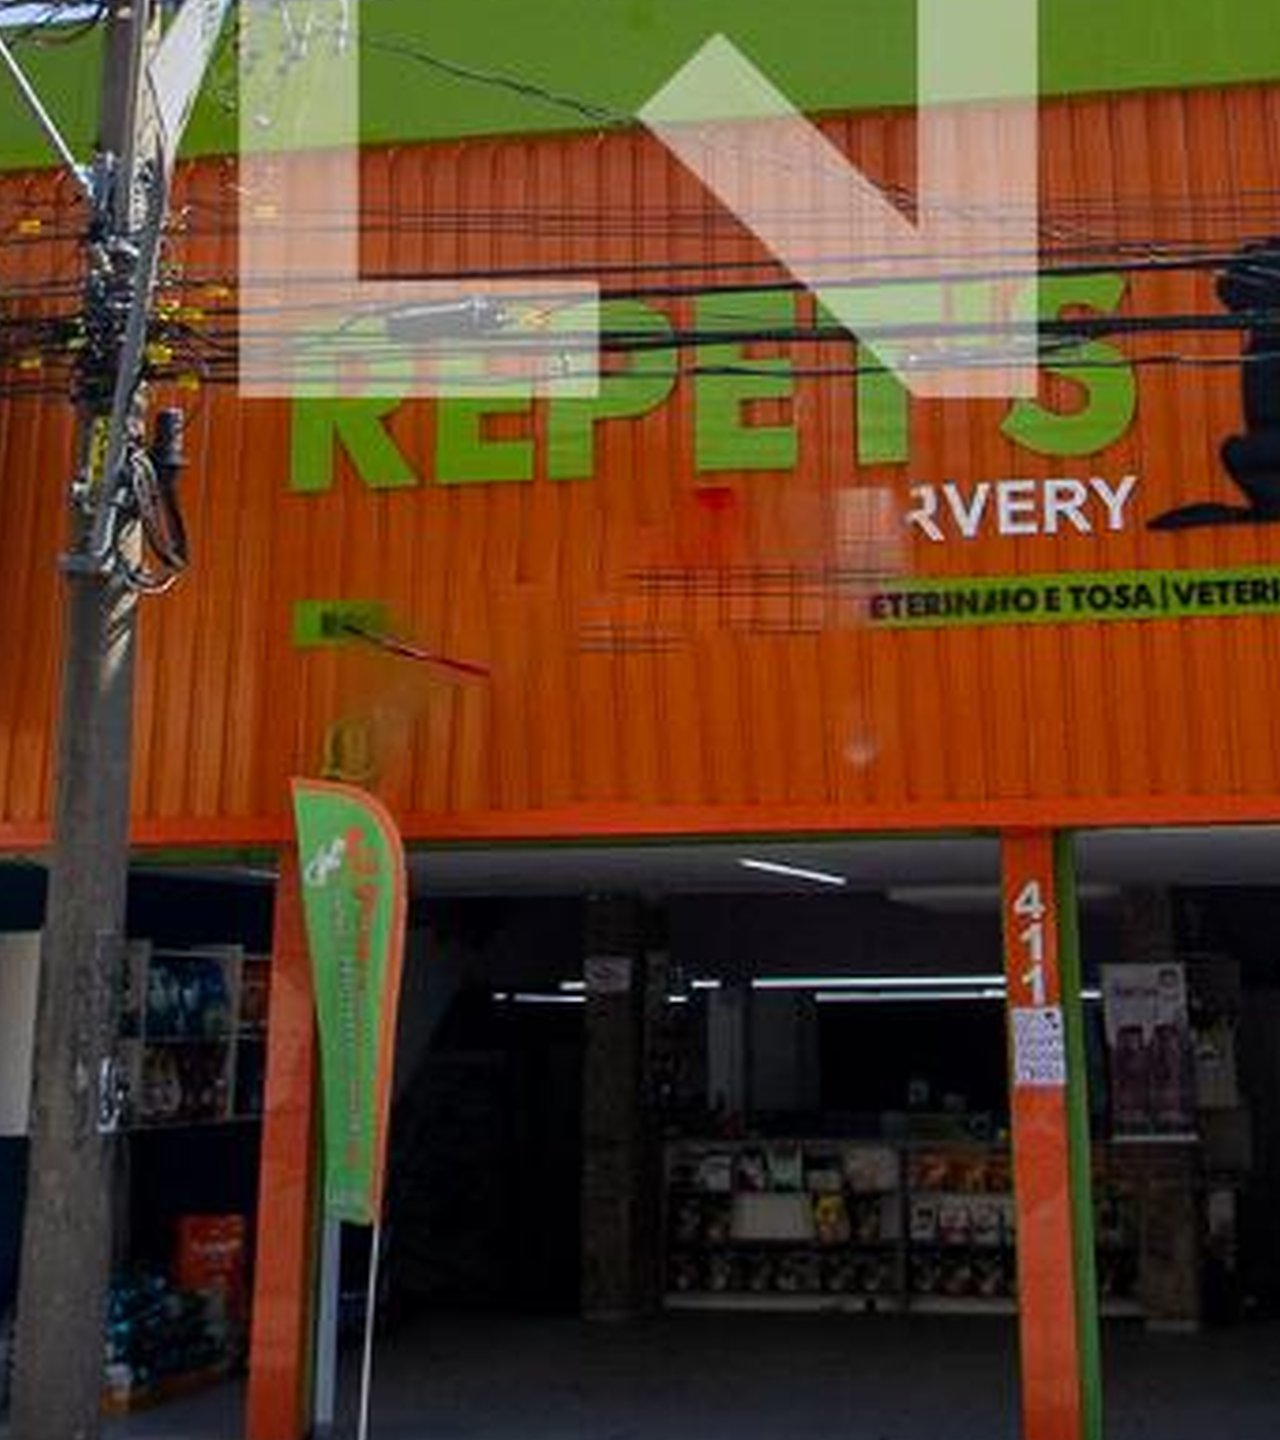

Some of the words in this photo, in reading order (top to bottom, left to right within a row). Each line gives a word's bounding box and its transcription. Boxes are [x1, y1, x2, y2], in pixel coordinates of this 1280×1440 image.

[287, 274, 1139, 493] REPETS
[1068, 583, 1155, 611] TOSA
[1015, 880, 1046, 1005] 411
